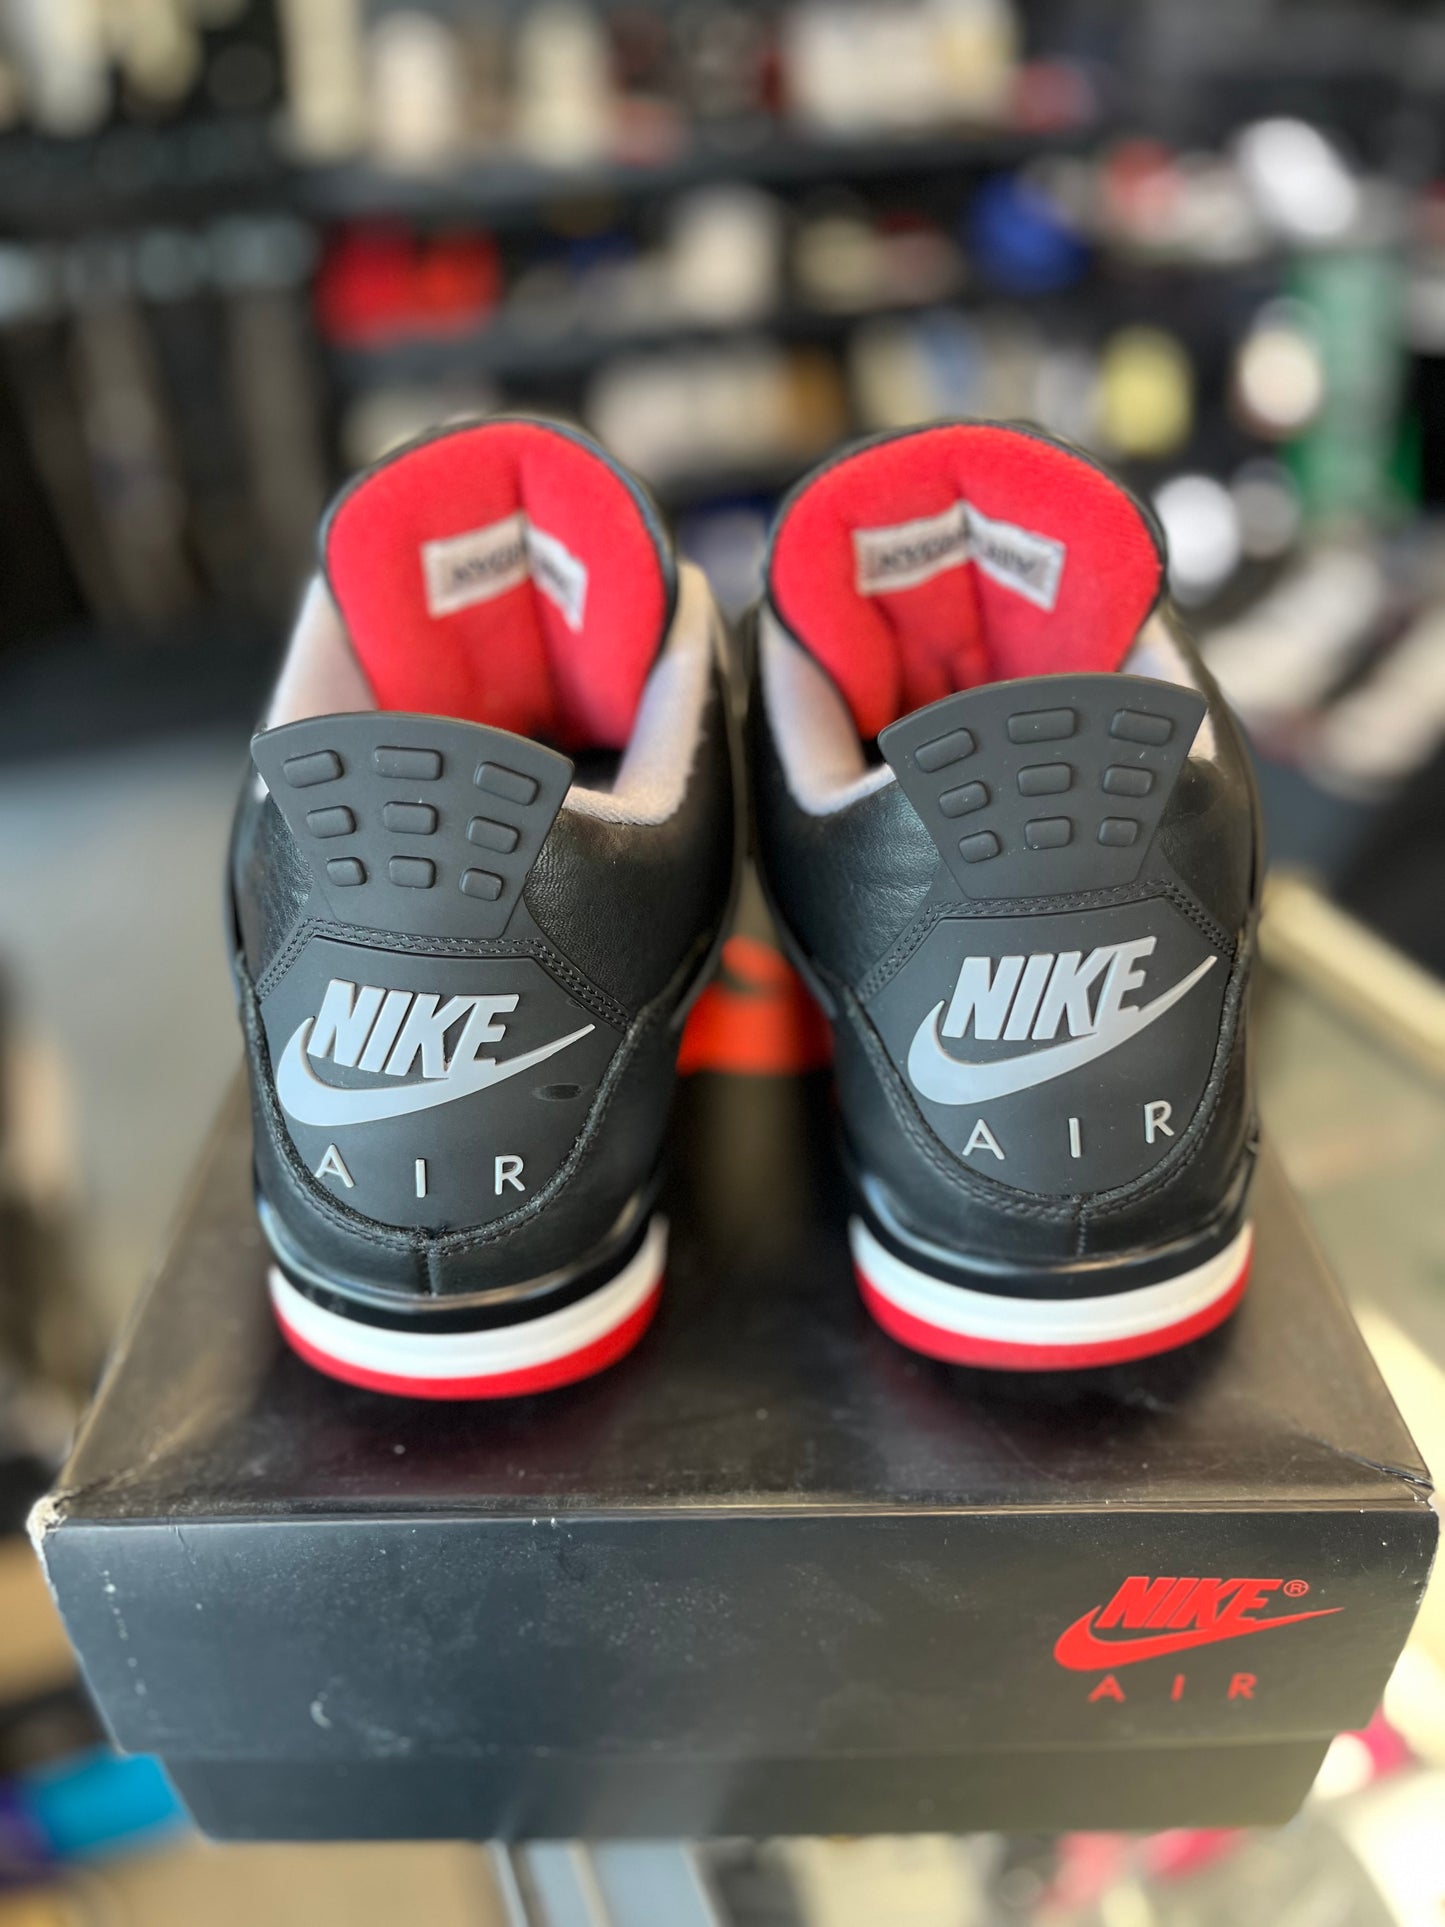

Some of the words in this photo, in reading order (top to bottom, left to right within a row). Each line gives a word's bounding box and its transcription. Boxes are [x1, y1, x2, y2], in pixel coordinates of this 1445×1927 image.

[942, 936, 1157, 1040] NIKE
[307, 978, 519, 1079] NIKE
[962, 1100, 1175, 1160] AIR
[314, 1143, 526, 1198] AIR
[1087, 1672, 1258, 1703] AIR
